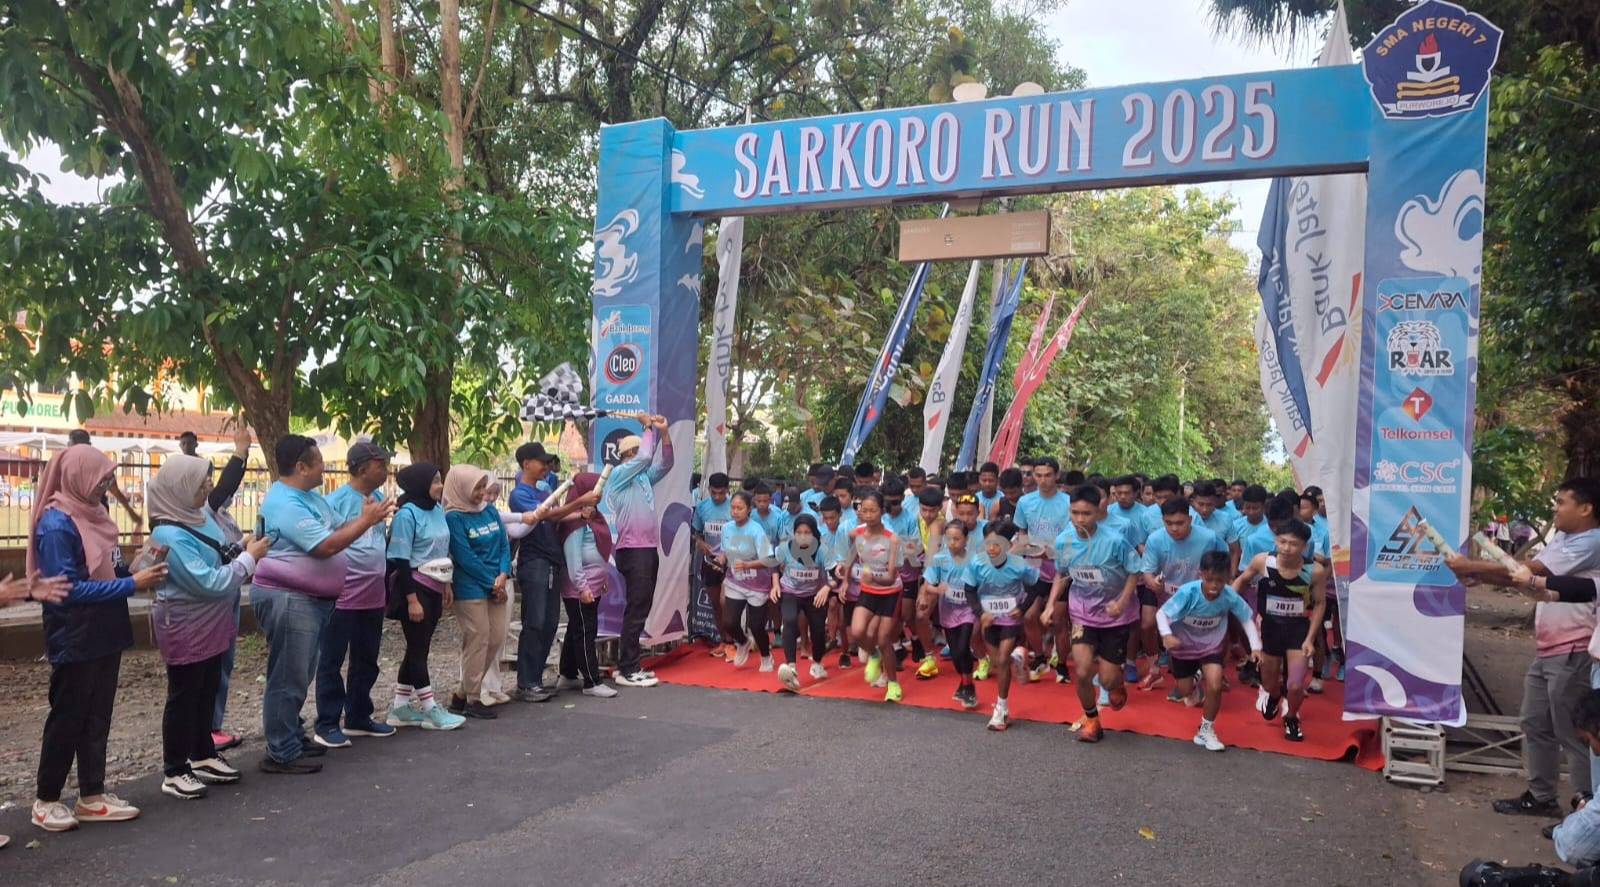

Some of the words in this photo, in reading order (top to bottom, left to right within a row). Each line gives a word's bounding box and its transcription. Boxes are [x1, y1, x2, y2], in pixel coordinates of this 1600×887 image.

[1376, 28, 1408, 57] SMA
[1412, 17, 1476, 38] NEGERI
[1473, 34, 1487, 45] 7
[733, 109, 961, 199] SARKORO
[981, 98, 1094, 180] RUN
[1121, 80, 1277, 168] 2025
[612, 354, 636, 373] Cleo
[4, 400, 64, 417] PUWORE
[605, 394, 641, 404] GARDA
[1381, 427, 1454, 441] Telkomsel
[1400, 460, 1457, 483] CSC
